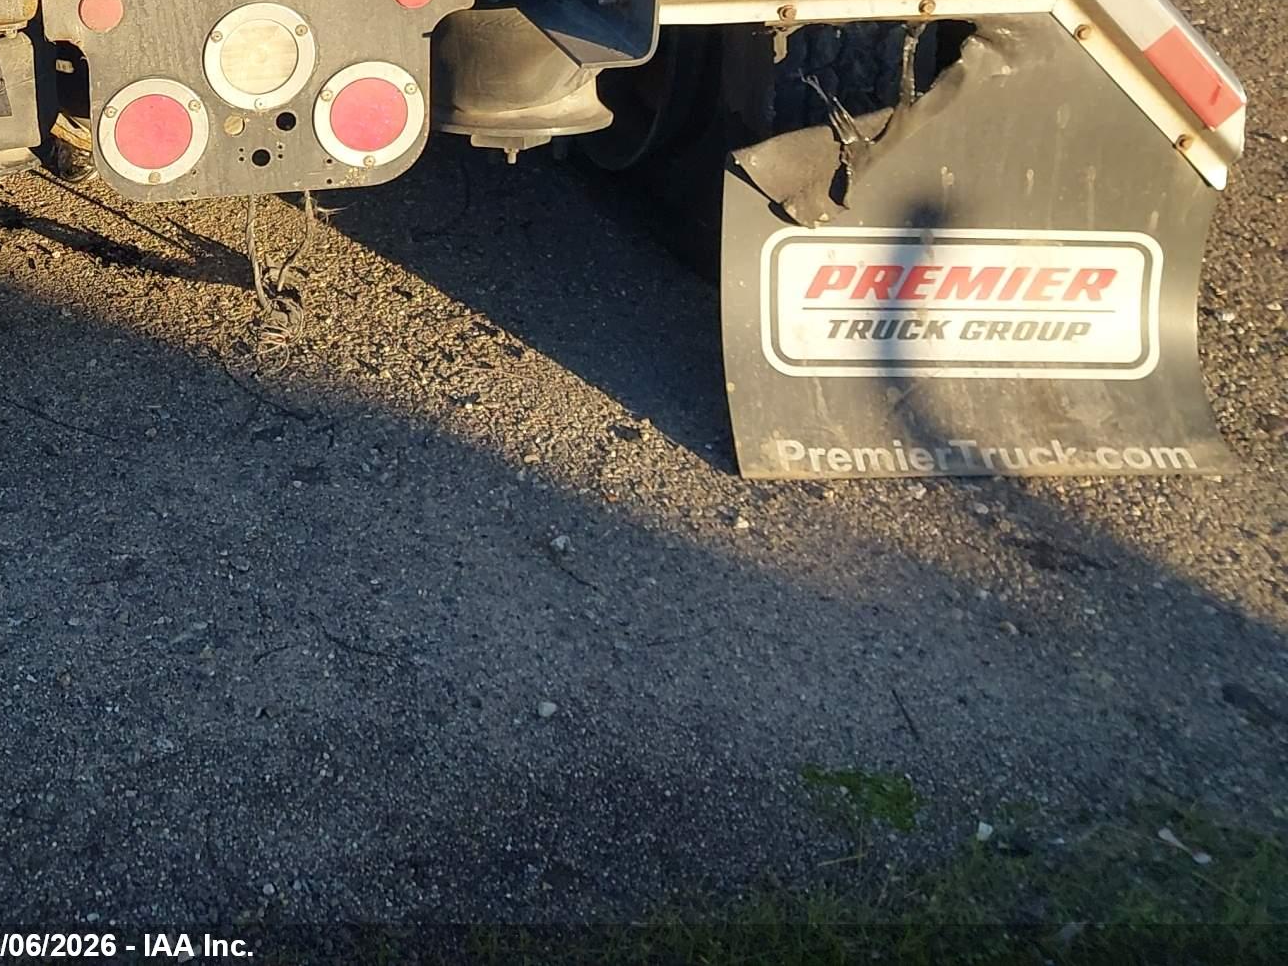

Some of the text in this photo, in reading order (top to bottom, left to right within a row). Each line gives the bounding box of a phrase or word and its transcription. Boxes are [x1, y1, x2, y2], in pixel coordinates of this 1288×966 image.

[804, 265, 1119, 302] PREMIER
[827, 319, 1092, 341] TRUCK GROUP
[776, 439, 1198, 473] PremierTruck.com
